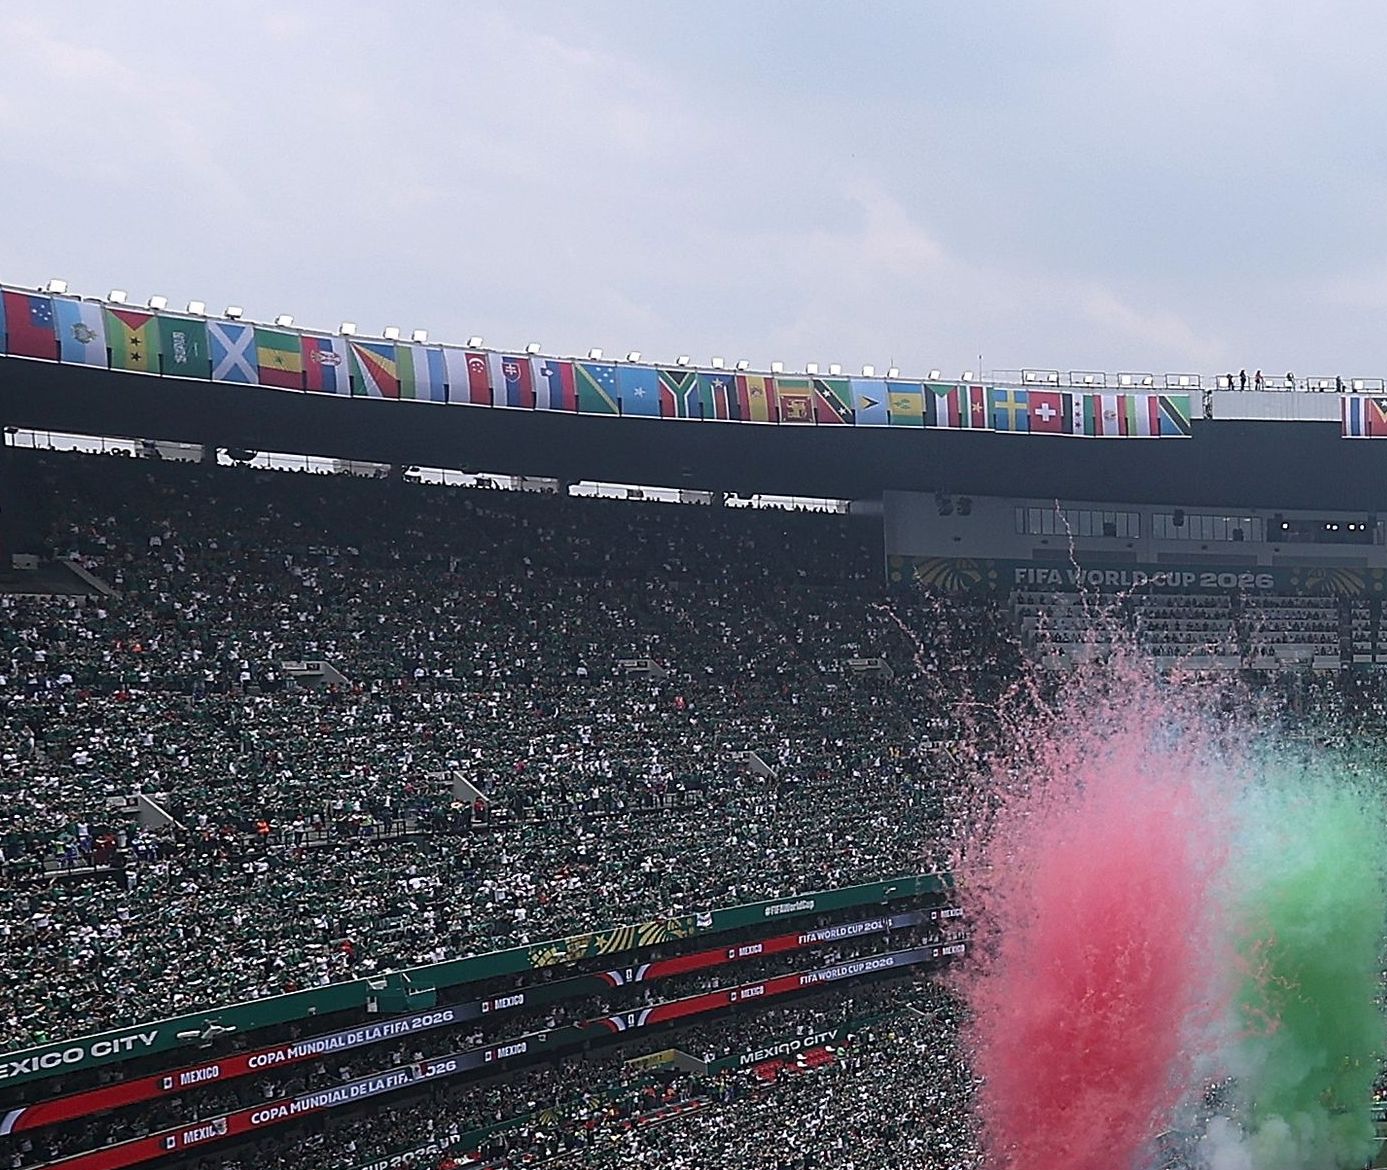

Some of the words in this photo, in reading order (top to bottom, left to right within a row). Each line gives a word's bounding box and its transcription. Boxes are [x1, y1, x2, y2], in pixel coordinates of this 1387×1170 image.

[1015, 568, 1062, 584] FIFA
[1066, 569, 1148, 587] WORLD
[1151, 571, 1195, 587] CUP
[1200, 573, 1275, 588] 2026
[798, 933, 817, 945] FIFA
[817, 927, 847, 941] WORLD
[847, 924, 864, 934] CUP
[739, 943, 763, 957] MEXICO
[800, 974, 818, 986] FIFA
[818, 967, 848, 980] WORLD
[848, 963, 865, 974] CUP
[865, 957, 894, 971] 2026
[494, 994, 524, 1011] MEXICO
[741, 985, 765, 1000] MEXICO
[90, 1031, 159, 1058] CITY
[248, 1052, 286, 1069] COPA
[287, 1036, 346, 1060] MUNDIAL
[347, 1030, 364, 1045] DE
[364, 1027, 382, 1041] LA
[383, 1020, 410, 1037] FIFA
[411, 1010, 454, 1031] 2026
[803, 1029, 838, 1048] CITY
[497, 1041, 528, 1060] MEXICO
[180, 1065, 219, 1086] MEXICO
[251, 1107, 289, 1125] COPA
[290, 1089, 349, 1114] MUNDIAL
[350, 1085, 367, 1099] DE
[368, 1079, 385, 1094] LA
